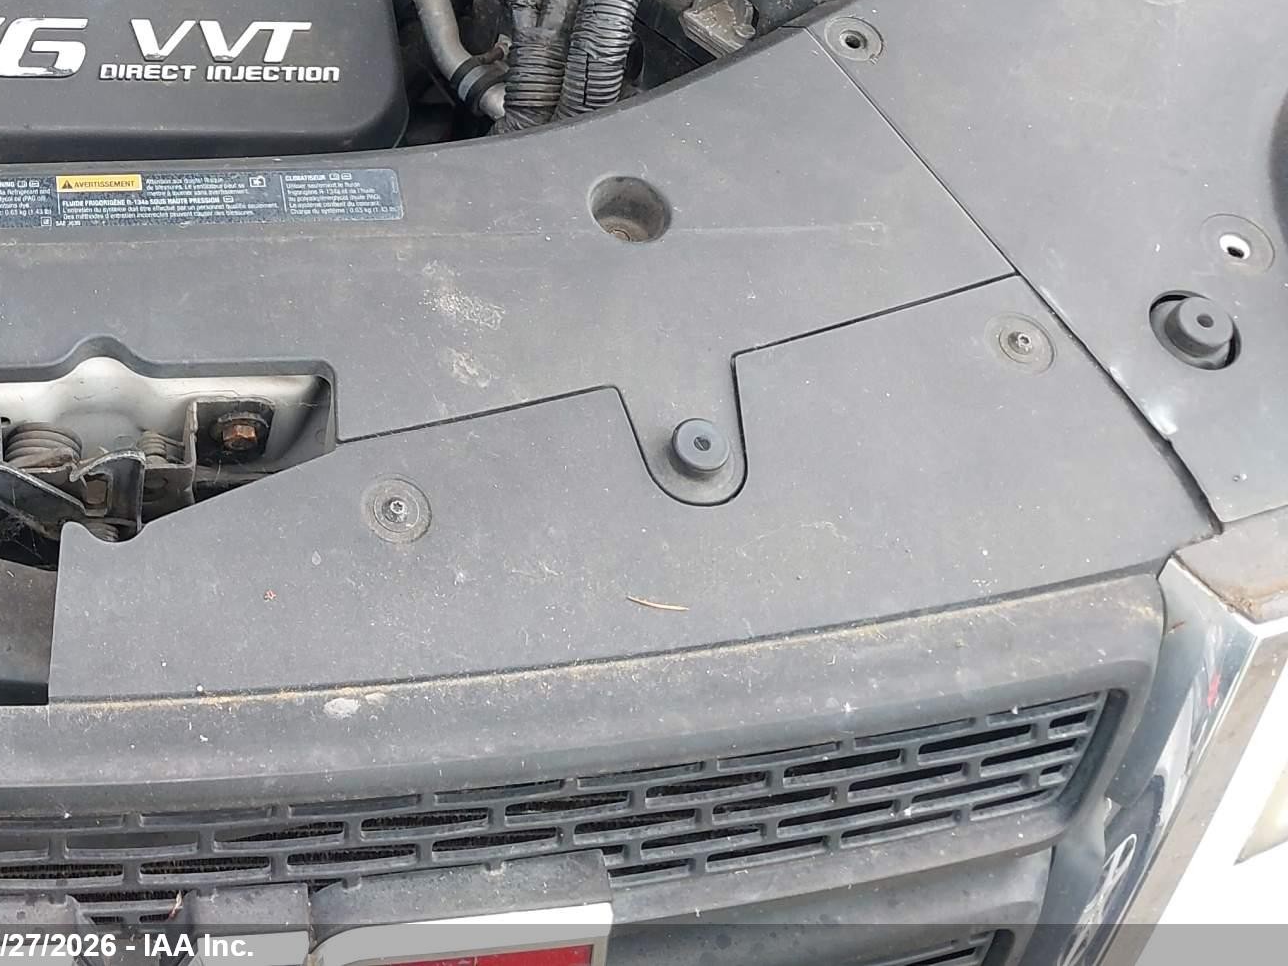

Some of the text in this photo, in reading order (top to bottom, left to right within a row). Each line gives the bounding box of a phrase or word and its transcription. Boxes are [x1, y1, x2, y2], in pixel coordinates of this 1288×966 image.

[130, 19, 312, 63] VVT
[99, 63, 340, 82] DIRECT INJECTION
[74, 180, 136, 188] AVERTISSEMENT
